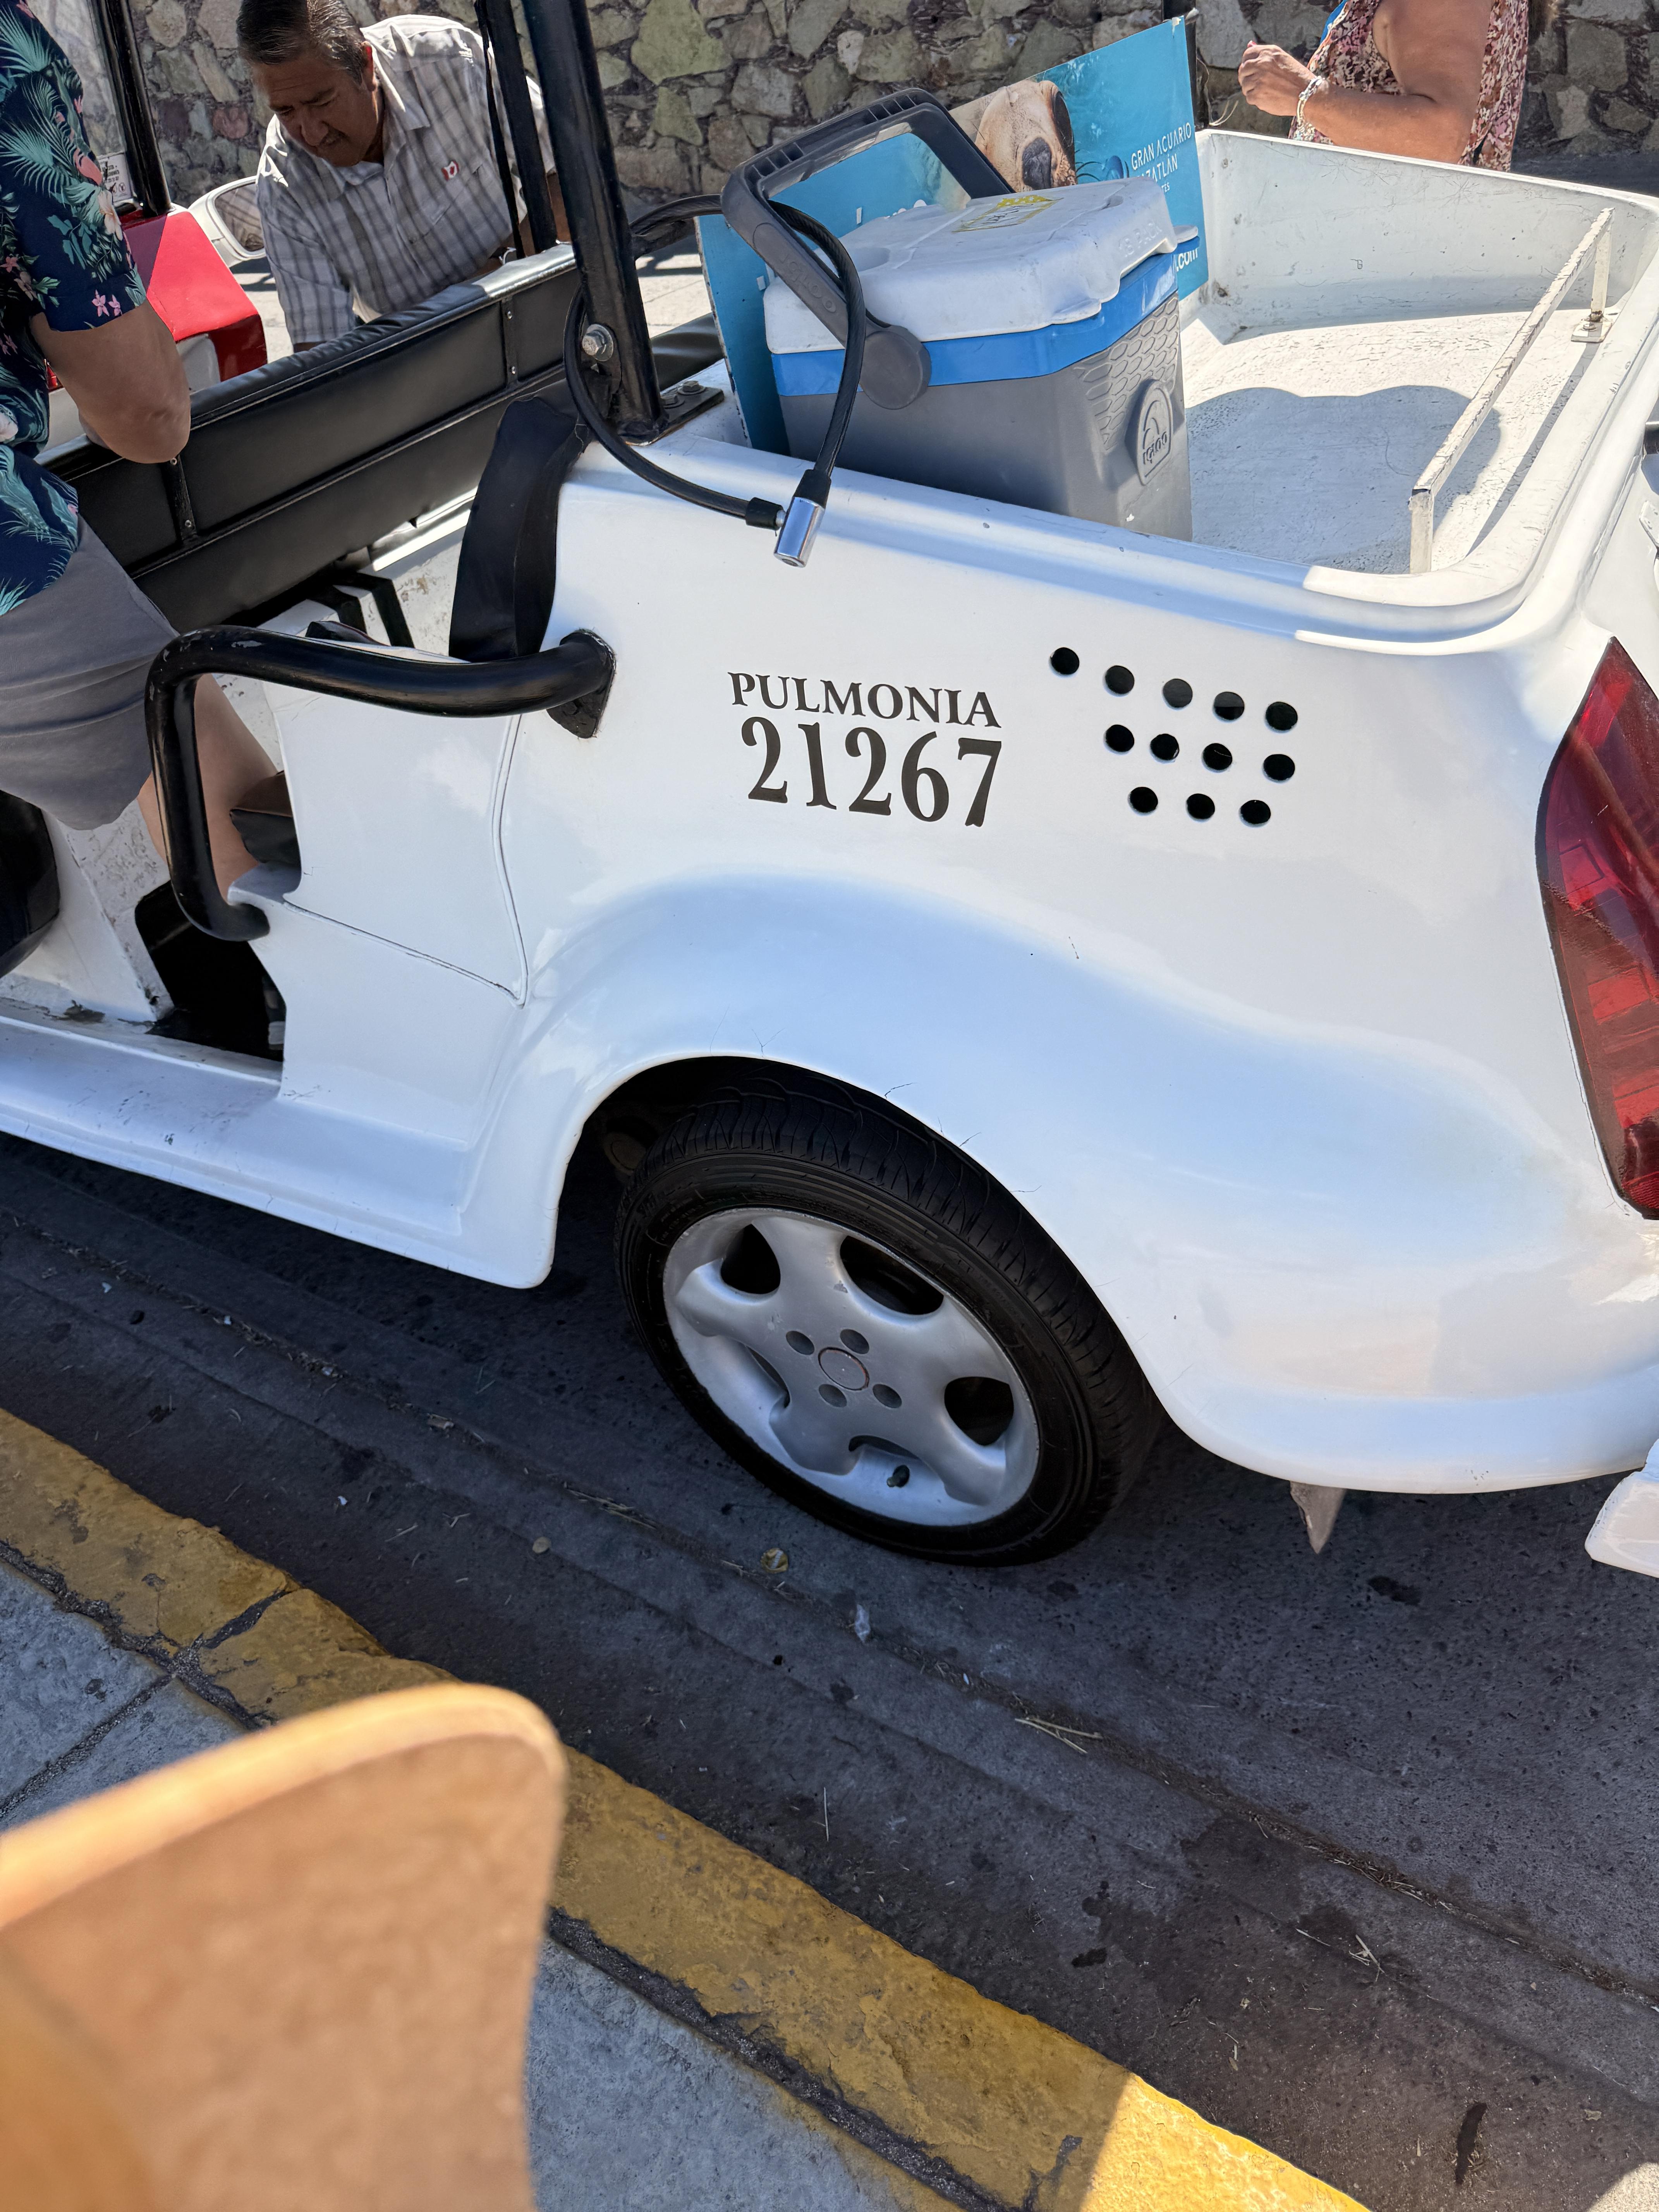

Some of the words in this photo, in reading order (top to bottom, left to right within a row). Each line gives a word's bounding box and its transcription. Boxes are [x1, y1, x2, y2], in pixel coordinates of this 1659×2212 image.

[1131, 143, 1154, 170] GRAN
[1157, 122, 1192, 157] ACUARIO
[1137, 153, 1178, 183] ZATLÁN
[728, 672, 1002, 728] PULMONIA
[741, 716, 1002, 827] 21267
